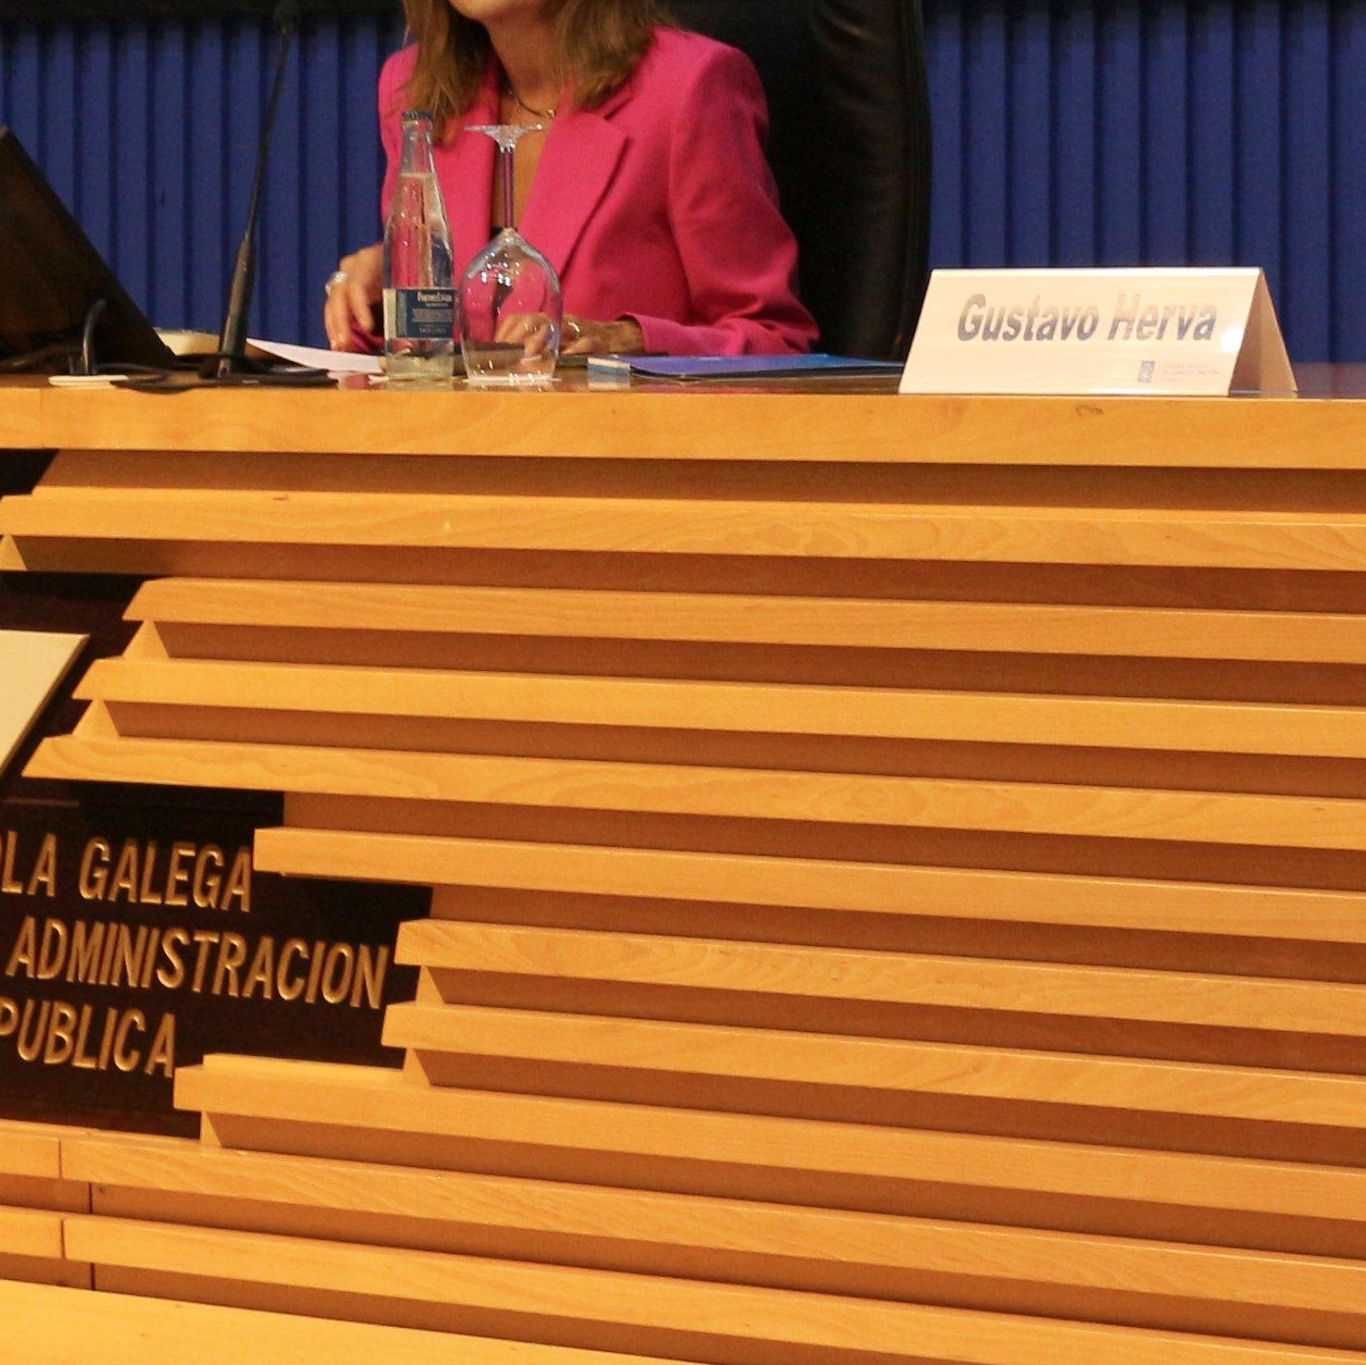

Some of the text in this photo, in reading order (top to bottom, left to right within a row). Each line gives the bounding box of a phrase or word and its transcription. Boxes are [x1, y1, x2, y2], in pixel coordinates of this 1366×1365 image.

[957, 292, 1218, 342] Gustavo Herva
[79, 836, 252, 913] GALEGA
[5, 916, 389, 1010] ADMINISTRACION
